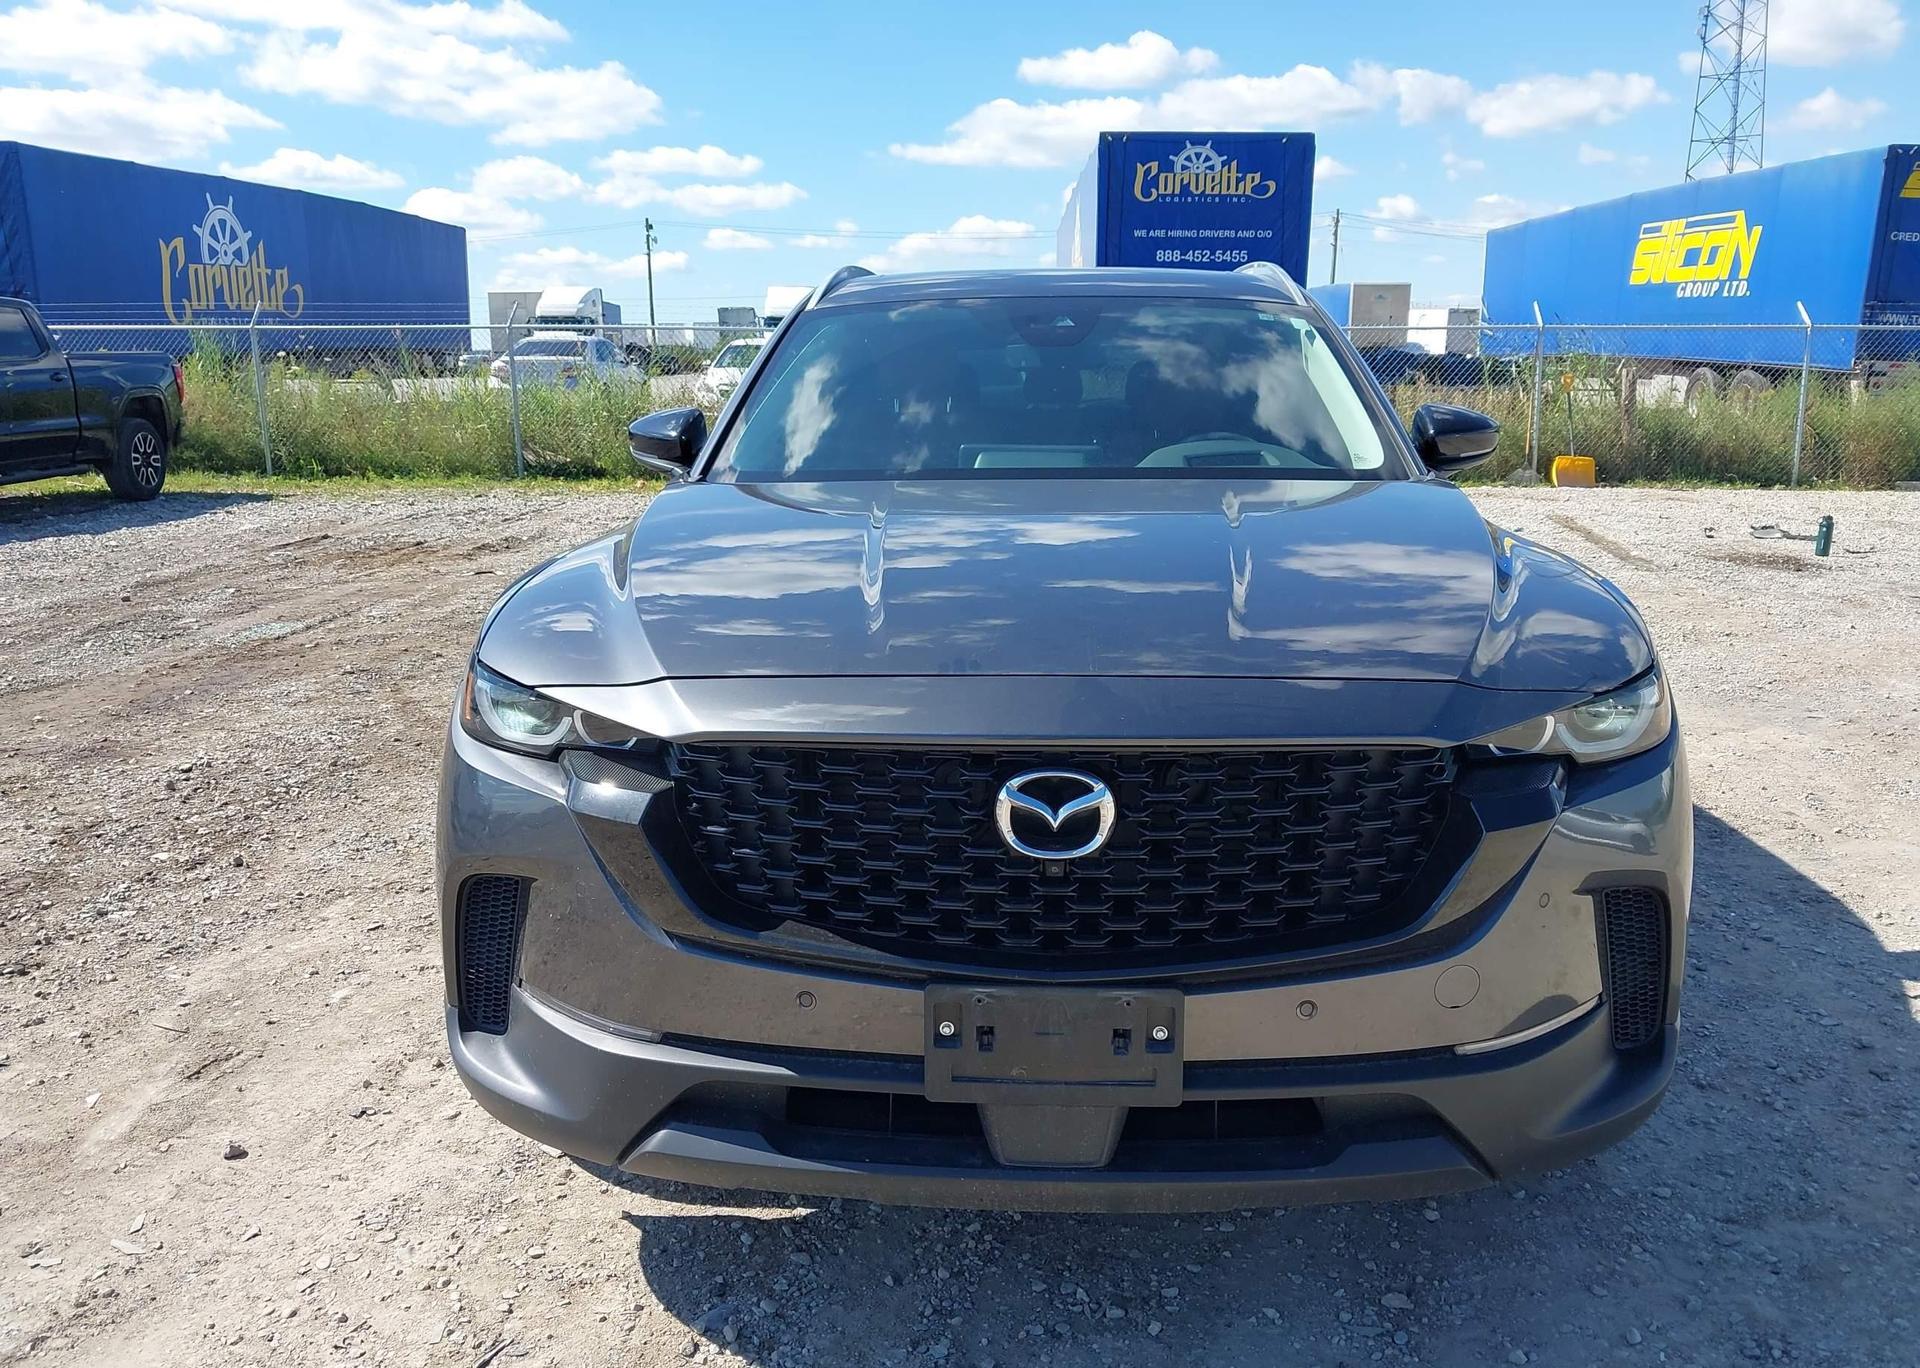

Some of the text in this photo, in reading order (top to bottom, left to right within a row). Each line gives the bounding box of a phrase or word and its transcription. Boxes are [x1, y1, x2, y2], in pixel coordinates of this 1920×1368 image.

[1134, 159, 1277, 202] Corvette
[1133, 229, 1273, 239] WE ARE HIRING DRIVERS AND O/O
[1155, 249, 1249, 262] 888-452-5455
[159, 236, 304, 325] Corvette
[1676, 280, 1751, 299] GROUP LTD.
